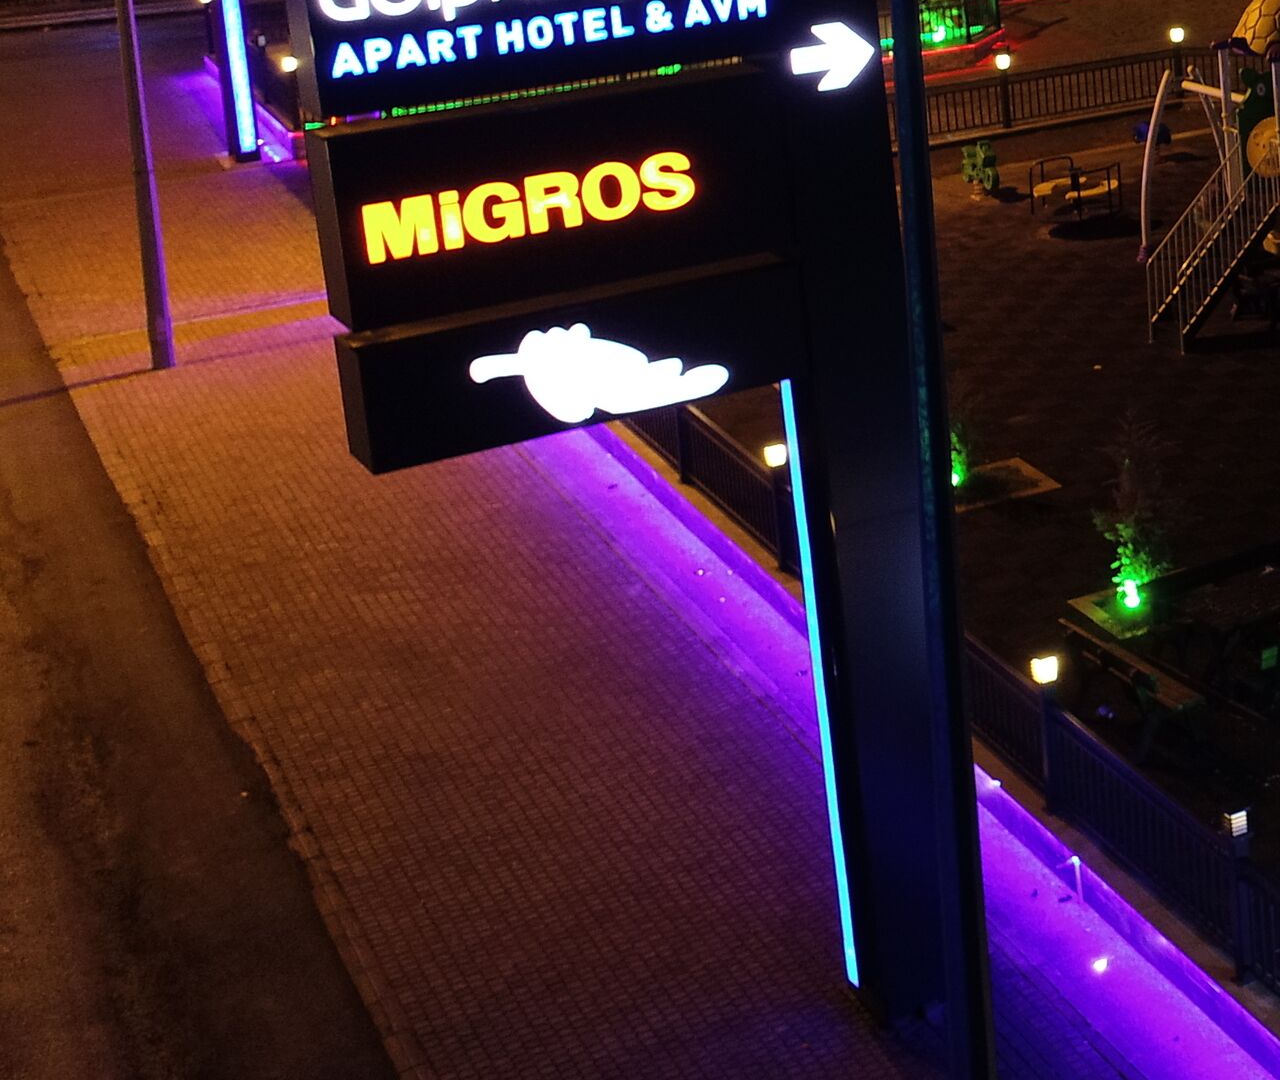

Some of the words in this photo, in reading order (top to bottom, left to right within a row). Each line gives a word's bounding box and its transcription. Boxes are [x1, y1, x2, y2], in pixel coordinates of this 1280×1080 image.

[332, 25, 482, 78] APART
[496, 6, 634, 55] HOTEL
[646, 0, 675, 33] &
